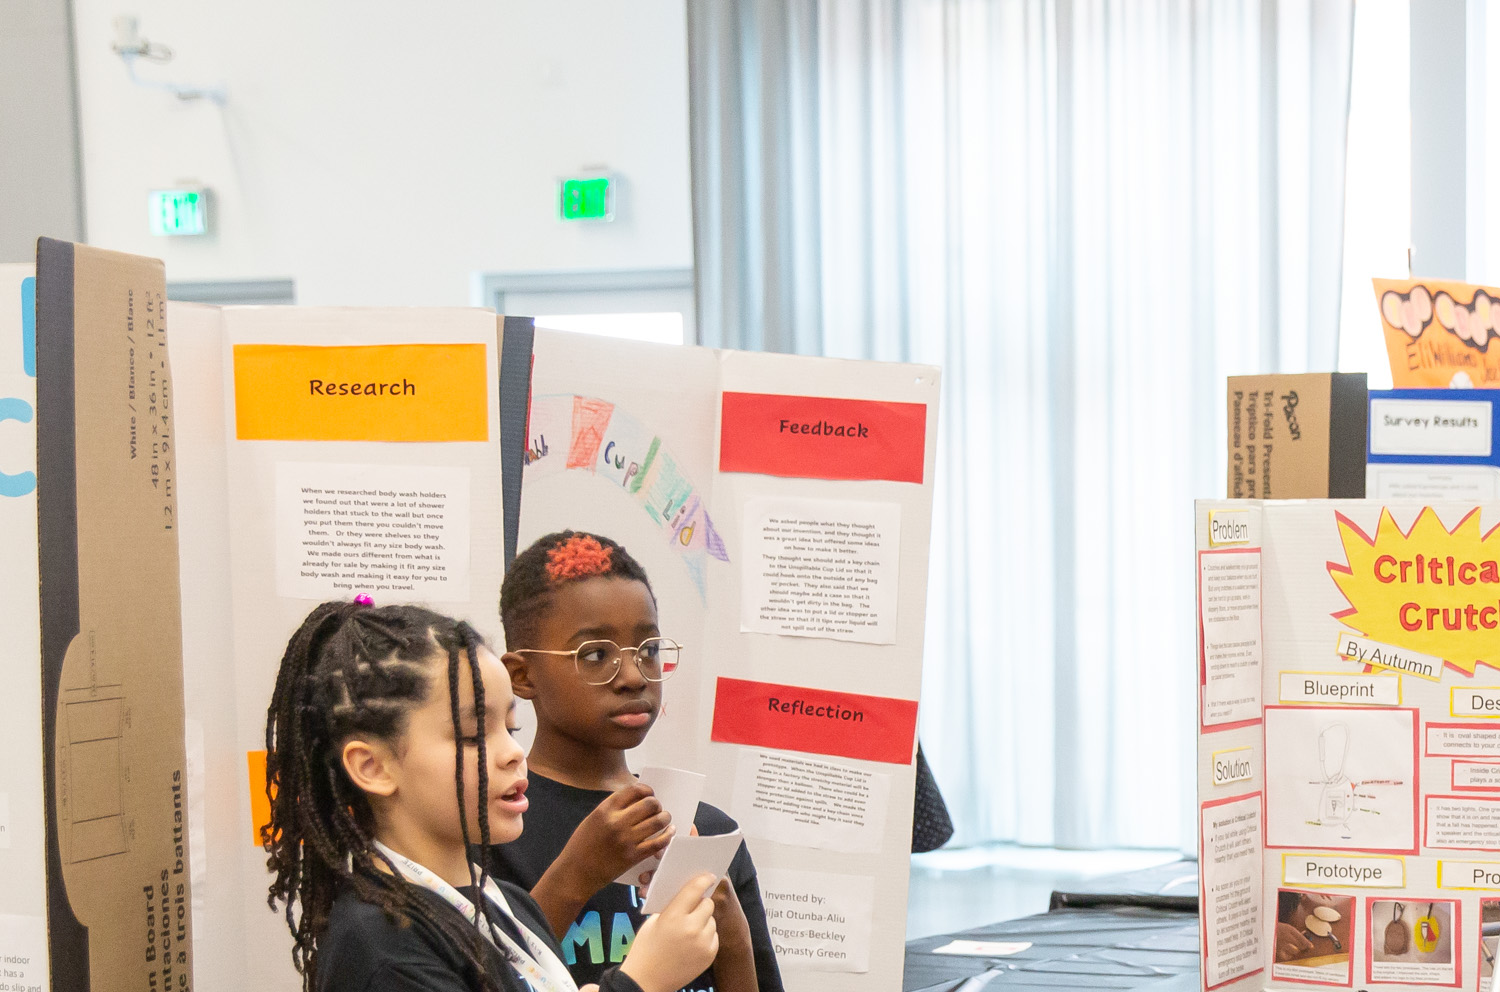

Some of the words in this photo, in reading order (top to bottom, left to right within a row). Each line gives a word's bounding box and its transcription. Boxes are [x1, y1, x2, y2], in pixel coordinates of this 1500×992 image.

[146, 318, 154, 337] 12
[148, 370, 156, 387] in
[309, 378, 415, 396] Research
[149, 392, 157, 416] 36
[1233, 391, 1243, 448] Panneau
[1263, 390, 1274, 440] Tri-Fold
[1281, 390, 1301, 441] Pacon
[1384, 415, 1429, 430] Survey
[1433, 415, 1479, 428] Results
[129, 416, 137, 459] White
[152, 424, 158, 434] x
[779, 419, 868, 438] Feedback
[150, 442, 158, 460] in
[164, 460, 171, 471] x
[604, 440, 639, 487] Cup
[1262, 444, 1273, 499] Present
[151, 464, 159, 488] 48
[1233, 453, 1243, 499] d'affich
[164, 478, 172, 497] m
[301, 486, 323, 494] When
[337, 488, 377, 496] researched
[378, 489, 397, 498] body
[419, 490, 447, 498] holders
[315, 497, 337, 505] found
[353, 498, 369, 506] that
[408, 500, 417, 508] of
[418, 501, 445, 509] shower
[163, 504, 173, 530] 1.2
[662, 499, 696, 546] Lid
[1209, 518, 1247, 543] Problem
[1346, 641, 1367, 663] By
[1369, 650, 1433, 677] Autumn
[1304, 680, 1374, 699] Blueprint
[768, 697, 863, 722] Reflection
[1457, 731, 1471, 739] oval
[1472, 732, 1497, 740] shaped
[1213, 759, 1251, 783] Solution
[1470, 766, 1489, 774] Inside
[1469, 776, 1487, 784] plays
[172, 770, 185, 875] battants
[1306, 861, 1382, 882] Prototype
[765, 890, 808, 902] Invented
[811, 893, 825, 905] by:
[174, 883, 186, 942] trois
[786, 909, 845, 923] Otunba-Aliu
[143, 885, 156, 962] Board
[768, 926, 846, 943] Rogers-Beckley
[3, 955, 30, 965] indoor
[176, 951, 186, 964] à
[773, 944, 814, 958] Dynasty
[816, 948, 846, 959] Green
[3, 968, 17, 978] has
[0, 982, 9, 992] do
